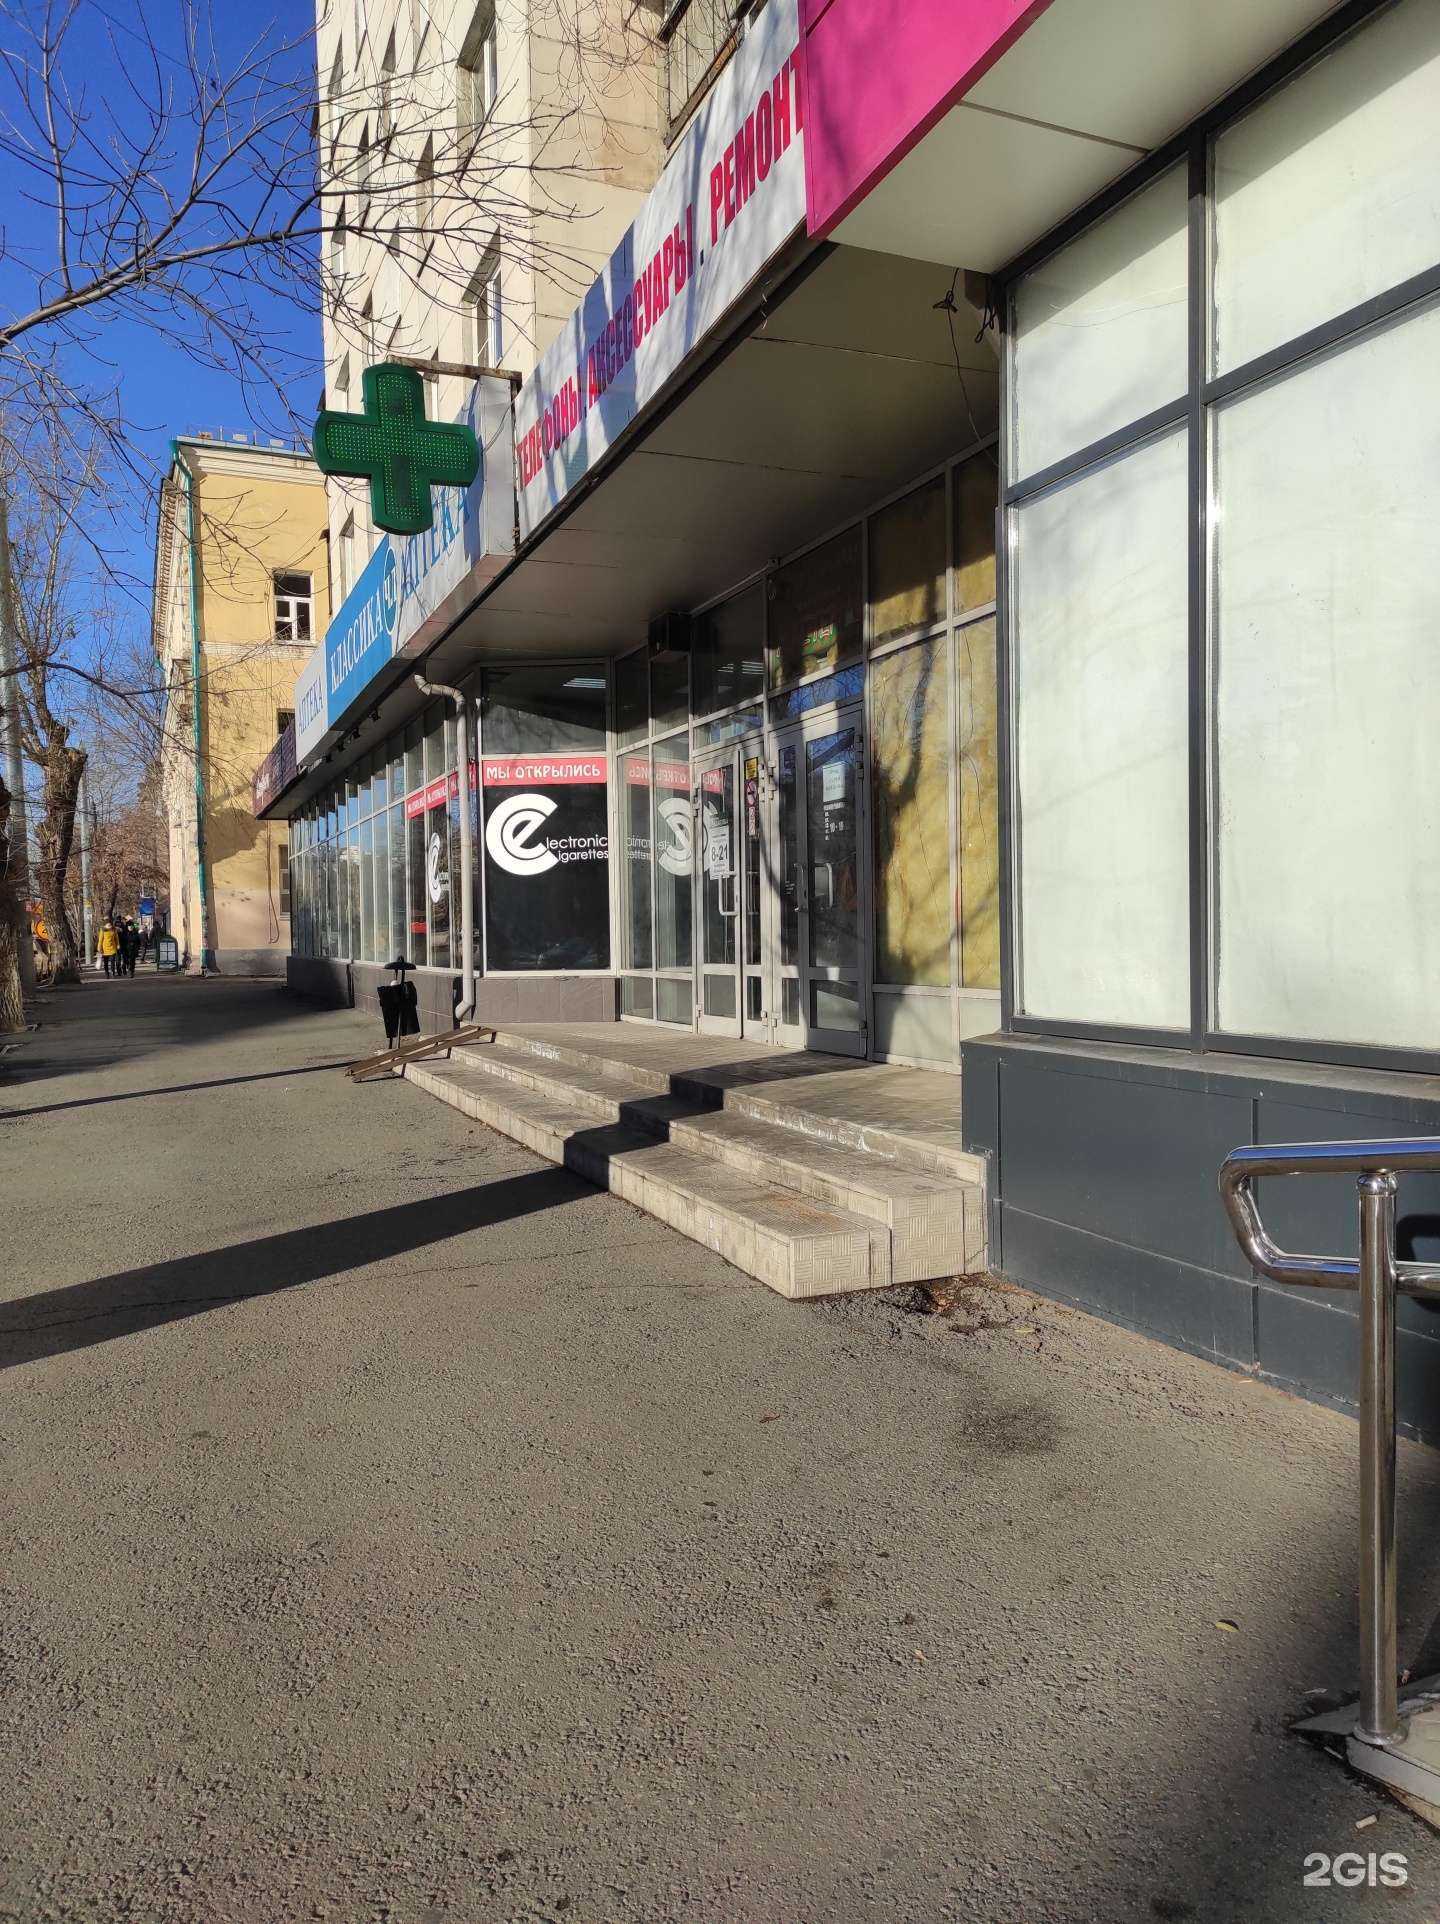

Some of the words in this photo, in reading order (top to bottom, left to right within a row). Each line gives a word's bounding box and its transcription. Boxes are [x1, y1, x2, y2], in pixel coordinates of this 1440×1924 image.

[710, 42, 803, 247] РЕМОНТ
[299, 677, 324, 736] АПТЕКА
[330, 584, 382, 694] КЛАССИКА
[486, 767, 510, 780] МЫ
[514, 764, 601, 778] ОТКРЫЛИСЬ
